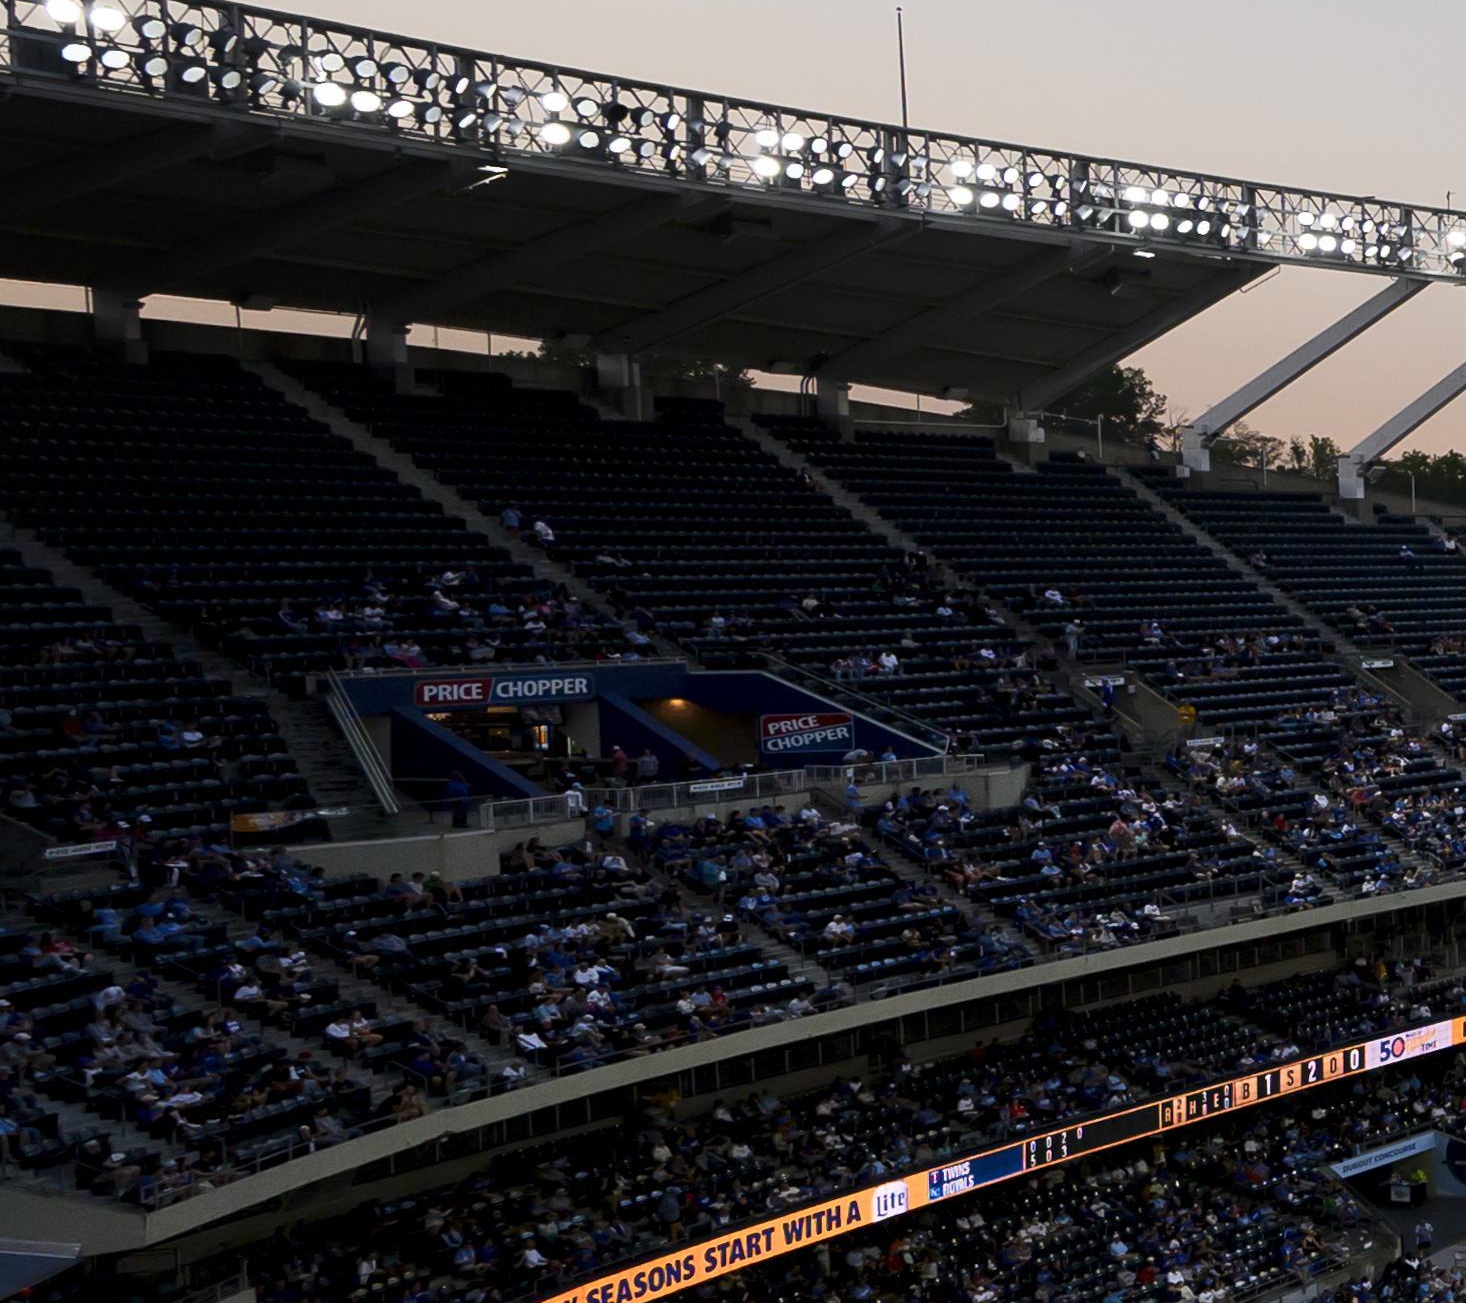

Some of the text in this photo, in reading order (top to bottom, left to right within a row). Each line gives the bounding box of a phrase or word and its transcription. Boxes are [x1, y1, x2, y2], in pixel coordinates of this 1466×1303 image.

[423, 678, 587, 701] PRICE CHOPPER
[767, 717, 818, 734] PRICE
[767, 727, 849, 751] CHOPPER
[1343, 1143, 1416, 1173] DUGOUT CONCOURSE
[942, 1161, 970, 1181] TWINS
[942, 1175, 974, 1196] ROYALS
[876, 1189, 905, 1217] Lite
[704, 1228, 775, 1273] START
[782, 1205, 841, 1245] WITH
[846, 1201, 861, 1223] A
